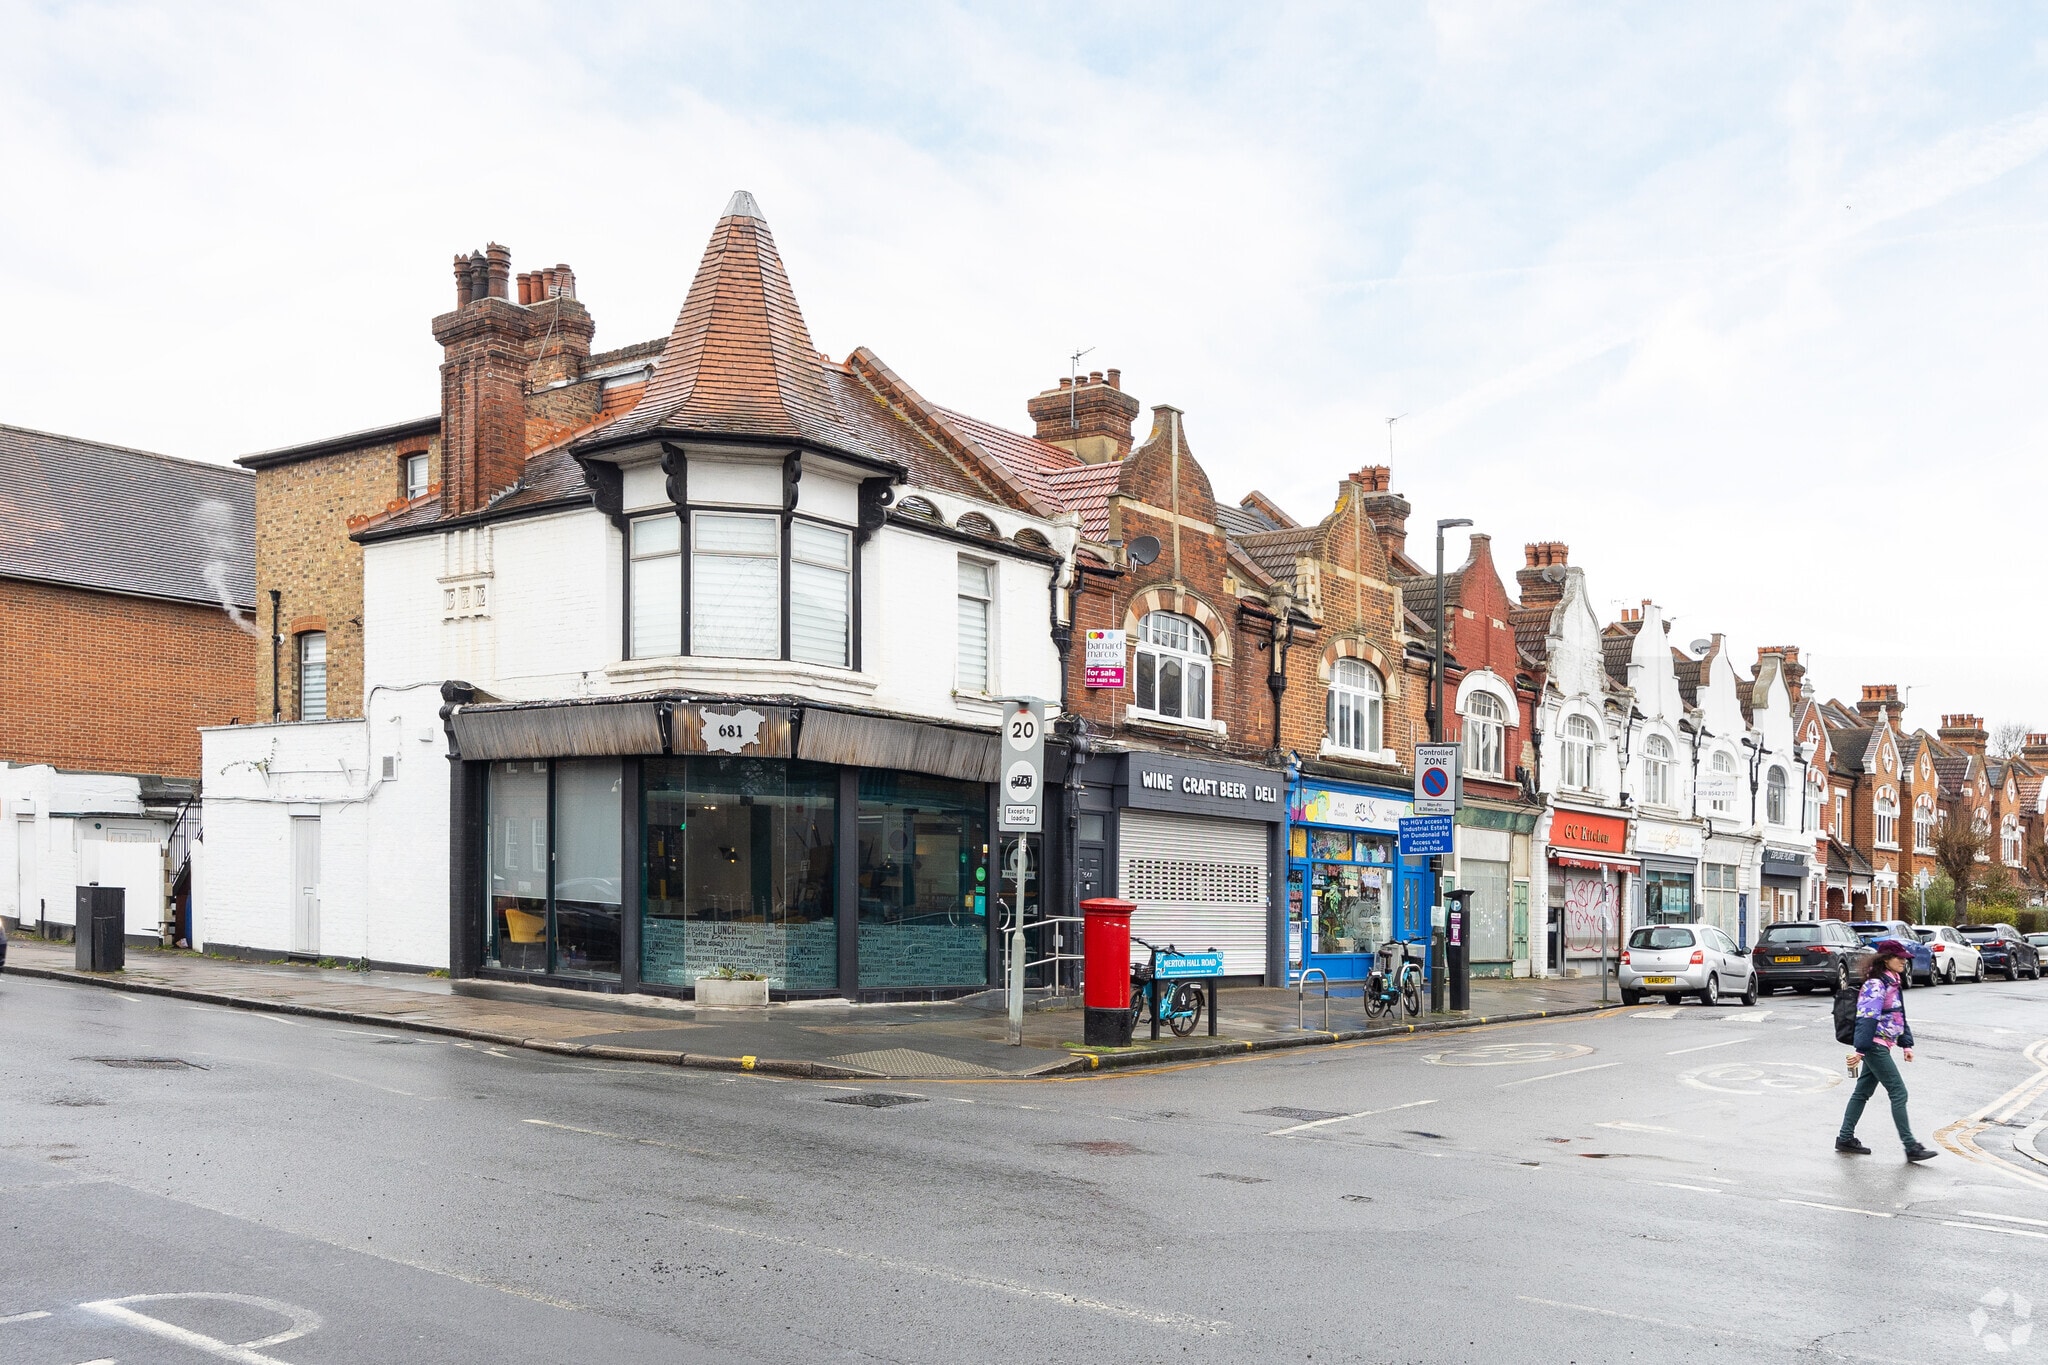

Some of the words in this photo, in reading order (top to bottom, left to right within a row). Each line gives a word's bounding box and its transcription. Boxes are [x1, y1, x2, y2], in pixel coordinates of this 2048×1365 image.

[1088, 640, 1122, 649] barnard
[1087, 650, 1118, 658] marcus
[719, 724, 742, 737] 681
[1012, 722, 1034, 738] 20
[1142, 771, 1173, 791] WINE
[1182, 776, 1218, 796] CRAFT
[1220, 781, 1247, 799] BEER
[1255, 785, 1277, 802] DELI
[1008, 808, 1025, 816] Except
[1354, 804, 1366, 814] art
[1565, 823, 1578, 839] GC
[1581, 826, 1609, 843] Kitchen
[713, 926, 737, 935] LUNCH
[724, 940, 746, 948] SOUP
[714, 947, 728, 956] Fresh
[729, 948, 747, 957] Coffee
[1187, 959, 1201, 967] HALL
